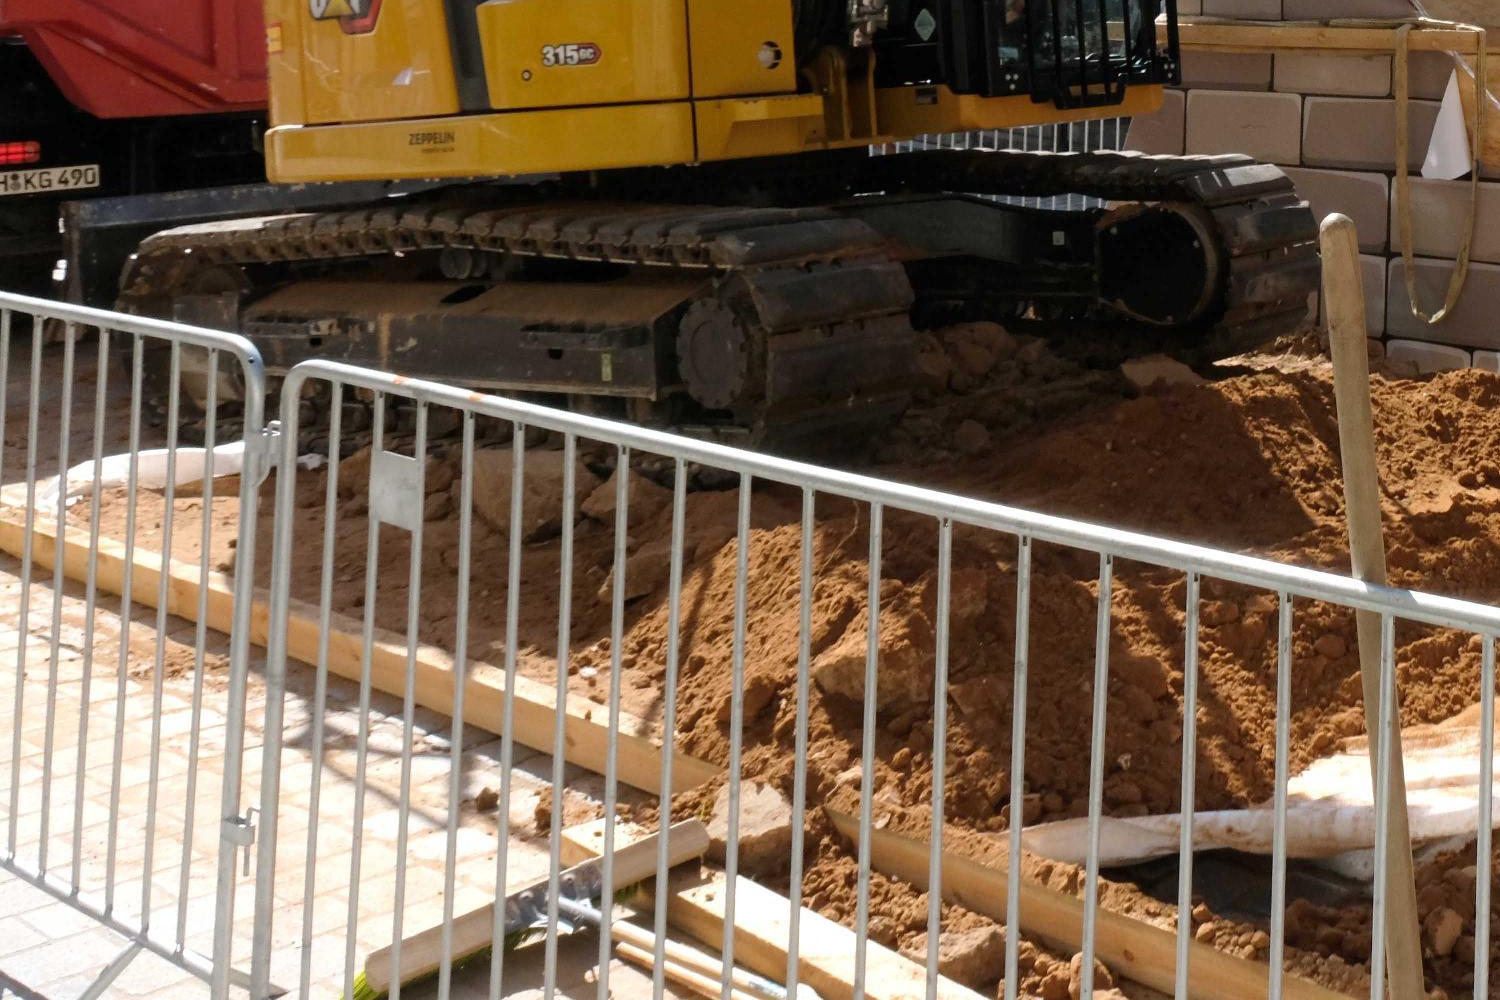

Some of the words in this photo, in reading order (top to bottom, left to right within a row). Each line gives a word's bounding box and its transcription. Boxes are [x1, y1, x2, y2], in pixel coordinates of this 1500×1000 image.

[408, 132, 456, 146] ZEPPELIN
[23, 171, 53, 190] KG
[57, 167, 97, 186] 490
